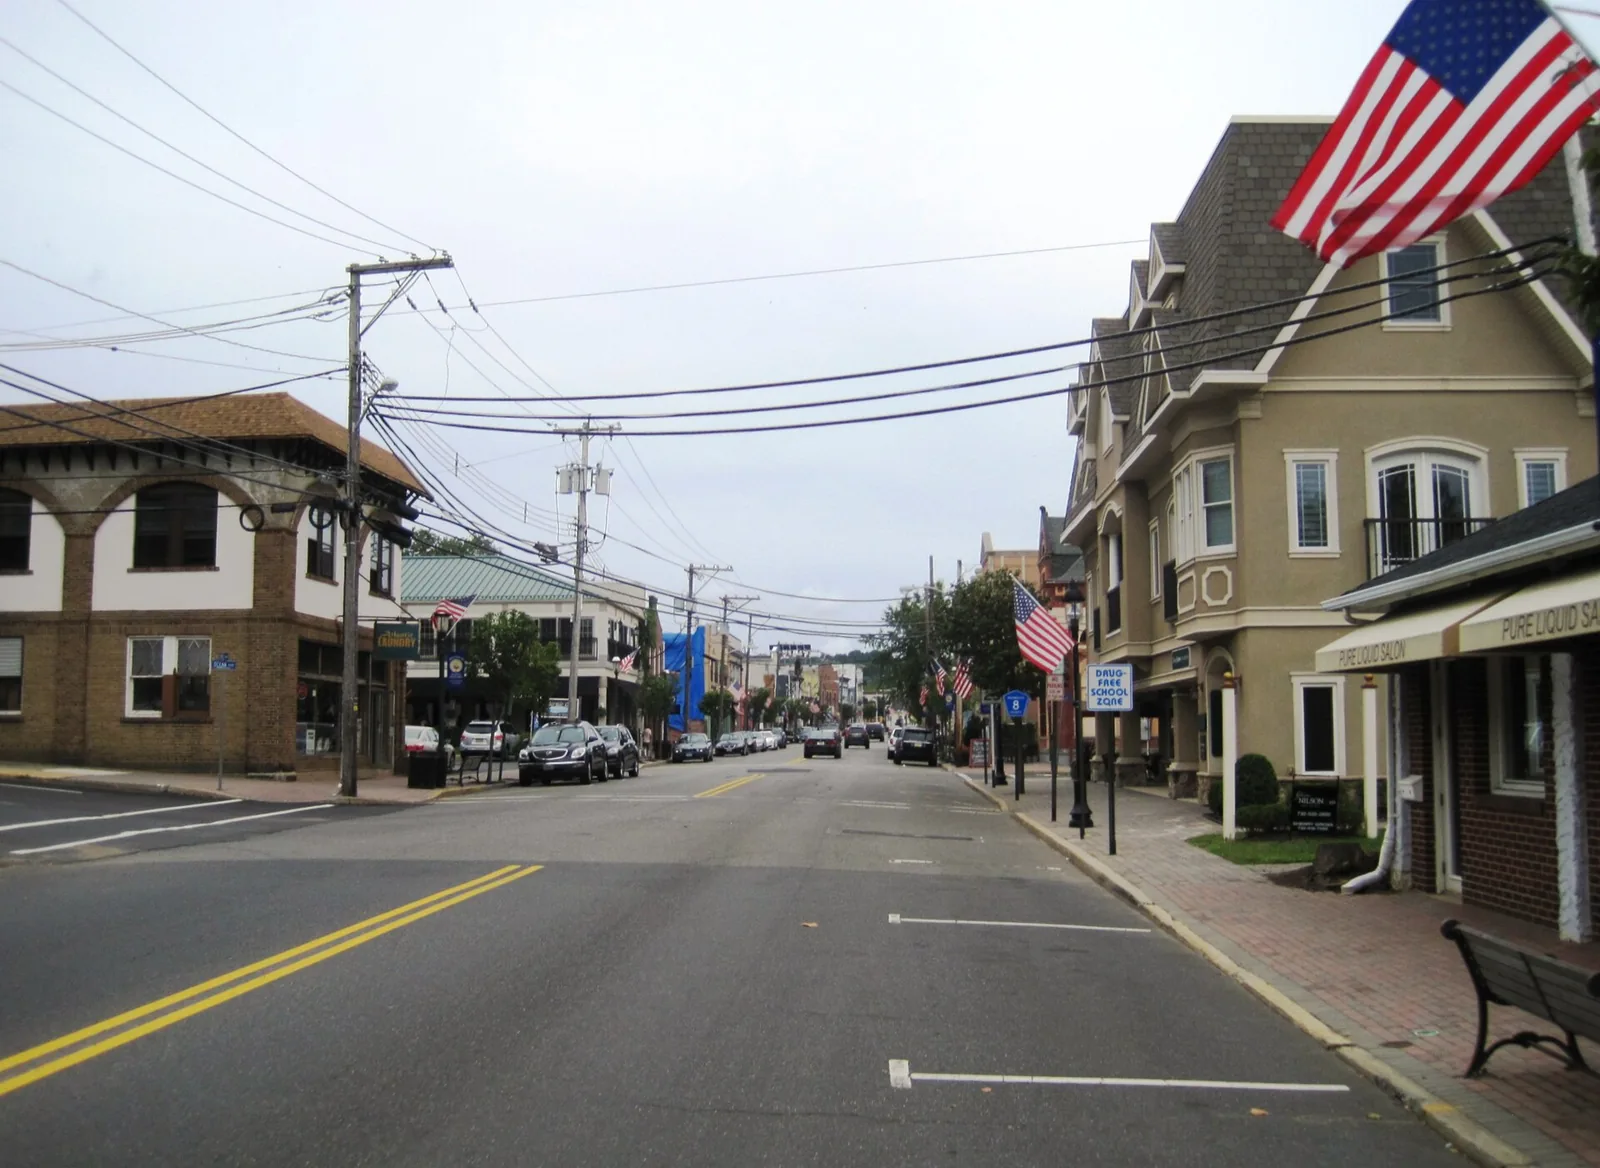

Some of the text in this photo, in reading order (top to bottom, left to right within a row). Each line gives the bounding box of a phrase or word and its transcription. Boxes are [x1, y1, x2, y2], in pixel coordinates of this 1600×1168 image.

[1502, 613, 1533, 641] PURE
[1536, 604, 1577, 635] LIQUID
[1339, 639, 1406, 667] PURE LIQUID SALON
[1095, 669, 1127, 678] DRUG-
[1098, 679, 1121, 687] FREE
[1091, 688, 1128, 697] SCHOOL
[1012, 699, 1020, 710] 8
[1097, 697, 1123, 706] ZONE
